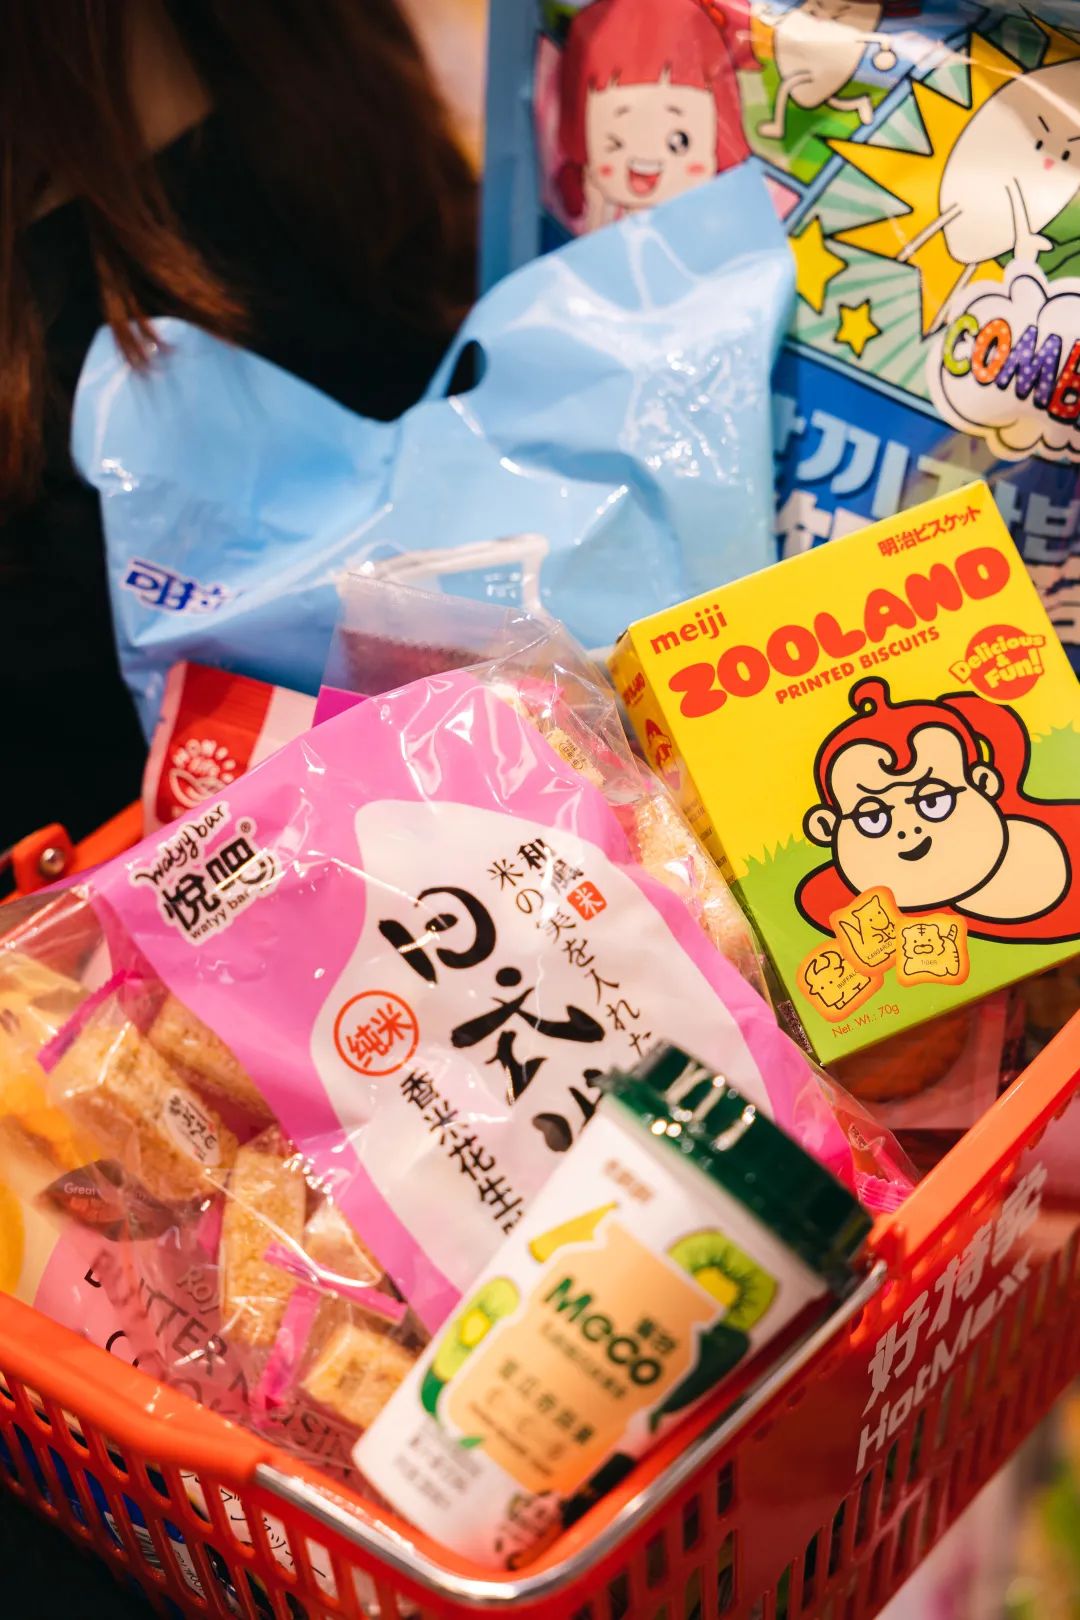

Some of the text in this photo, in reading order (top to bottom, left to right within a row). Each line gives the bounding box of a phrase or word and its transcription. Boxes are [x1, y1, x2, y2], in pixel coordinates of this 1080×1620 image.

[877, 505, 981, 557] 明治ビスケット
[650, 604, 727, 655] meiji
[668, 547, 1011, 719] ZOOLAND
[949, 634, 1046, 683] Delicious
[775, 626, 940, 705] PRINTED BISCUITS
[187, 804, 225, 838] bar
[162, 837, 275, 931] 悦吧
[571, 883, 605, 918] 米
[346, 1003, 413, 1068] 纯米
[831, 1024, 853, 1037] Net.
[878, 1003, 900, 1019] 70g
[400, 1070, 524, 1235] 香米花生
[544, 1276, 662, 1387] Meco
